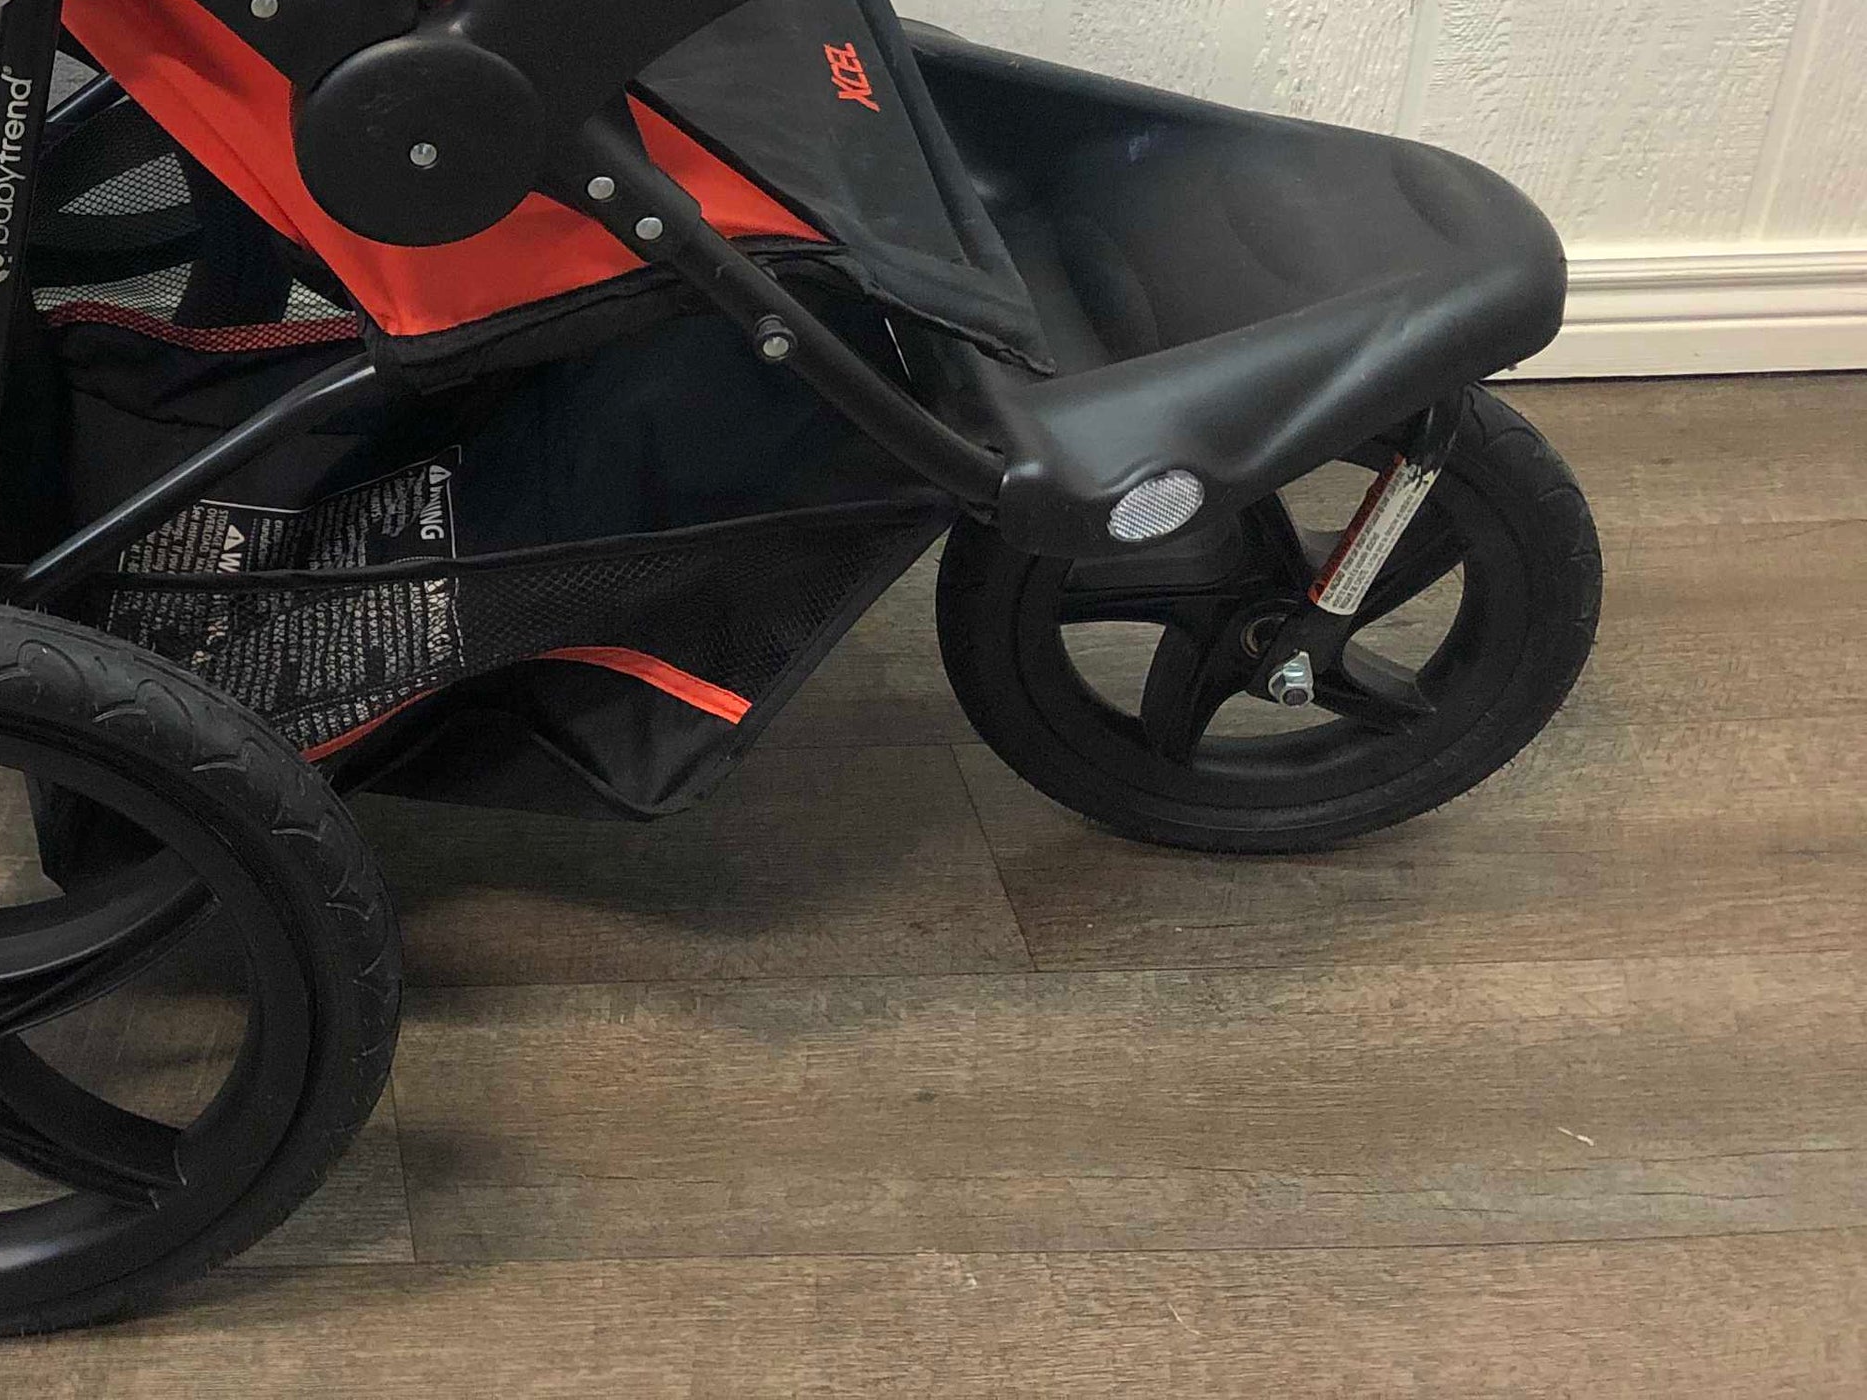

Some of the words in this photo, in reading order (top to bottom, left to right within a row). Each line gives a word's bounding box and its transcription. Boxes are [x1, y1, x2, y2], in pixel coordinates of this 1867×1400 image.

[823, 42, 880, 112] XCEL
[191, 504, 205, 520] See
[213, 509, 229, 546] STORAGE
[180, 521, 201, 571] instructions
[204, 549, 220, 574] BASKE
